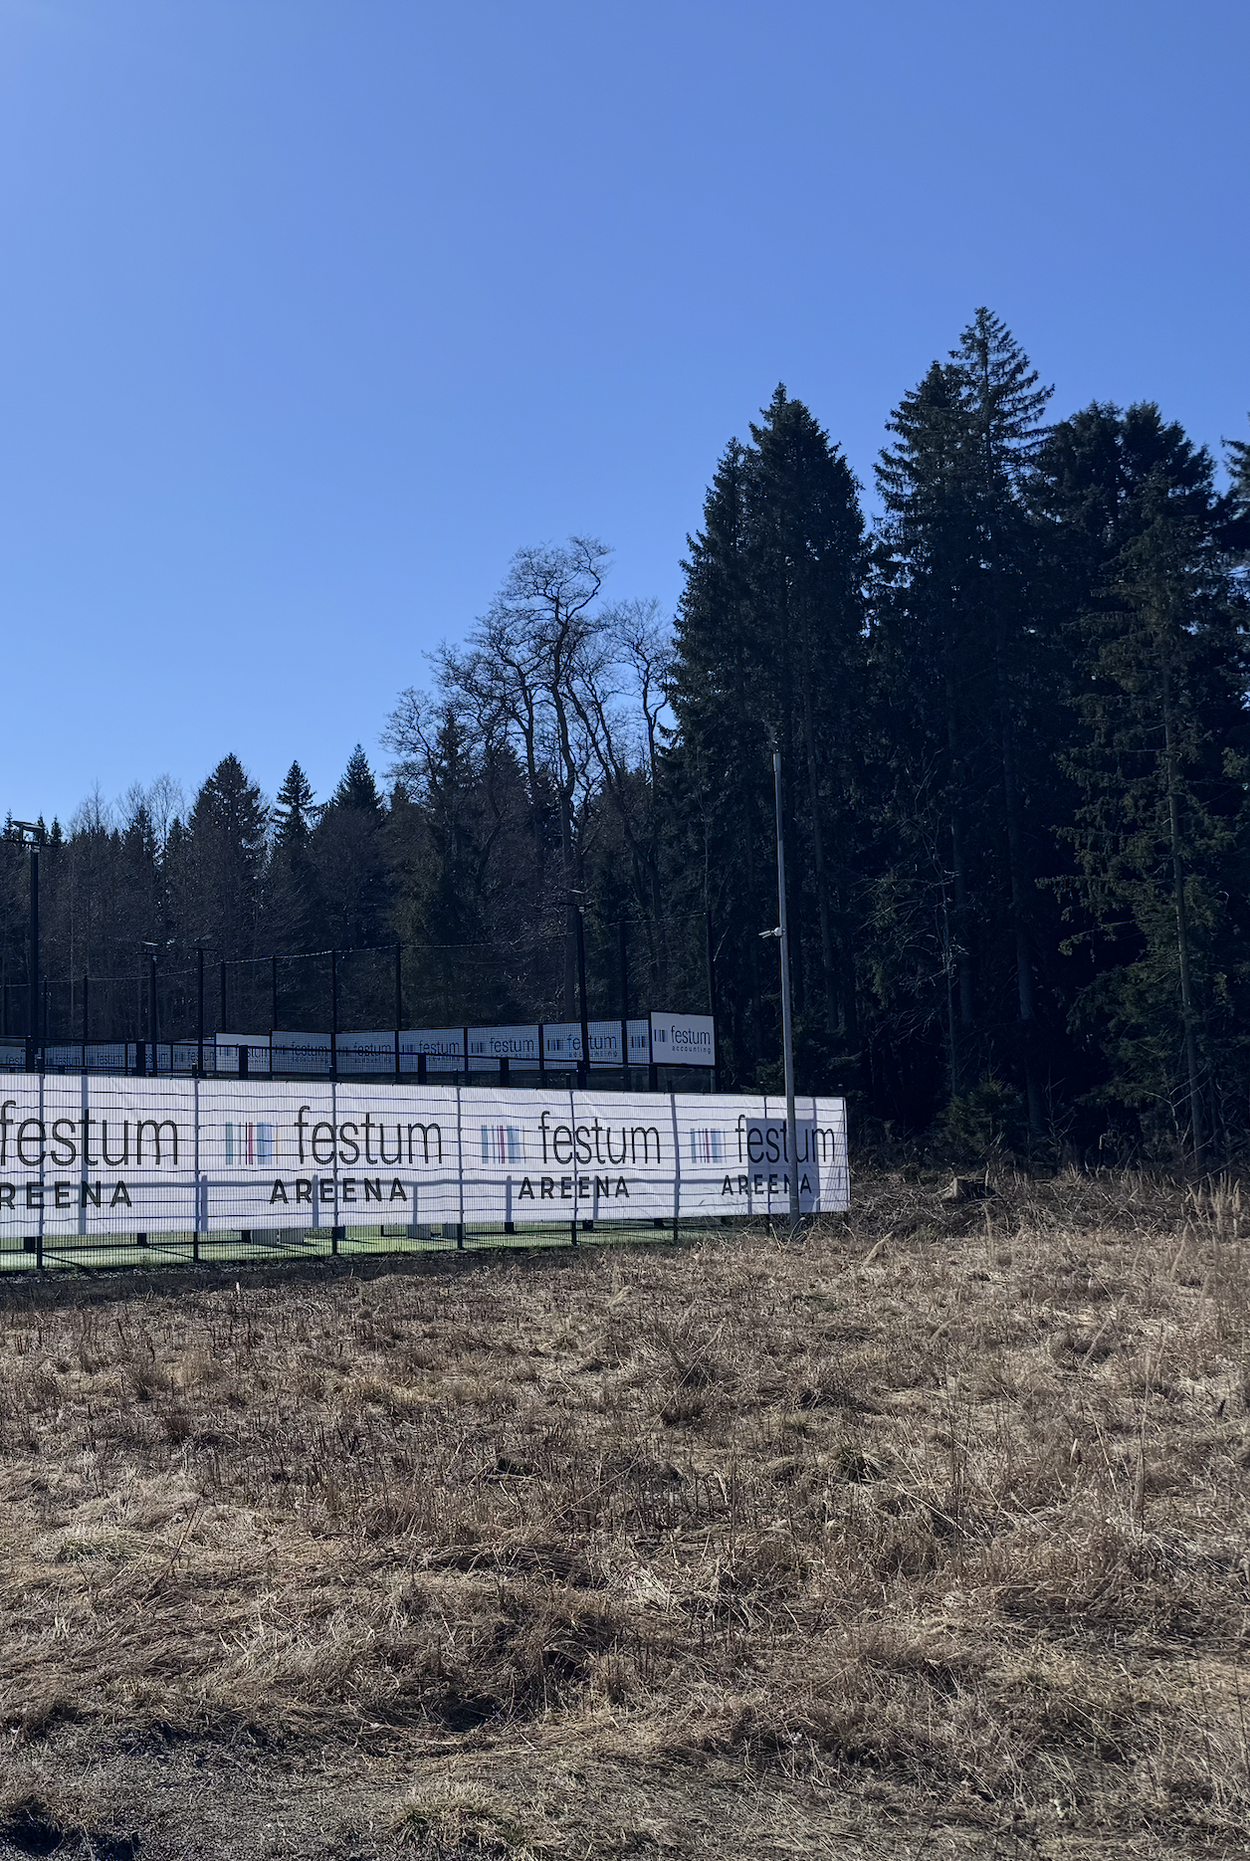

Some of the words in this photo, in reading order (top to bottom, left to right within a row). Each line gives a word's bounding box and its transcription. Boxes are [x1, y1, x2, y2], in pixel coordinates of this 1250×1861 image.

[490, 1038, 535, 1053] festum
[567, 1034, 617, 1050] fetum
[671, 1025, 711, 1045] festum
[419, 1040, 460, 1055] festum
[672, 1046, 711, 1055] accounting
[293, 1105, 443, 1166] festum
[537, 1111, 661, 1165] festum
[734, 1114, 836, 1164] festum
[269, 1177, 409, 1205] AREENA
[517, 1175, 631, 1200] AREENA
